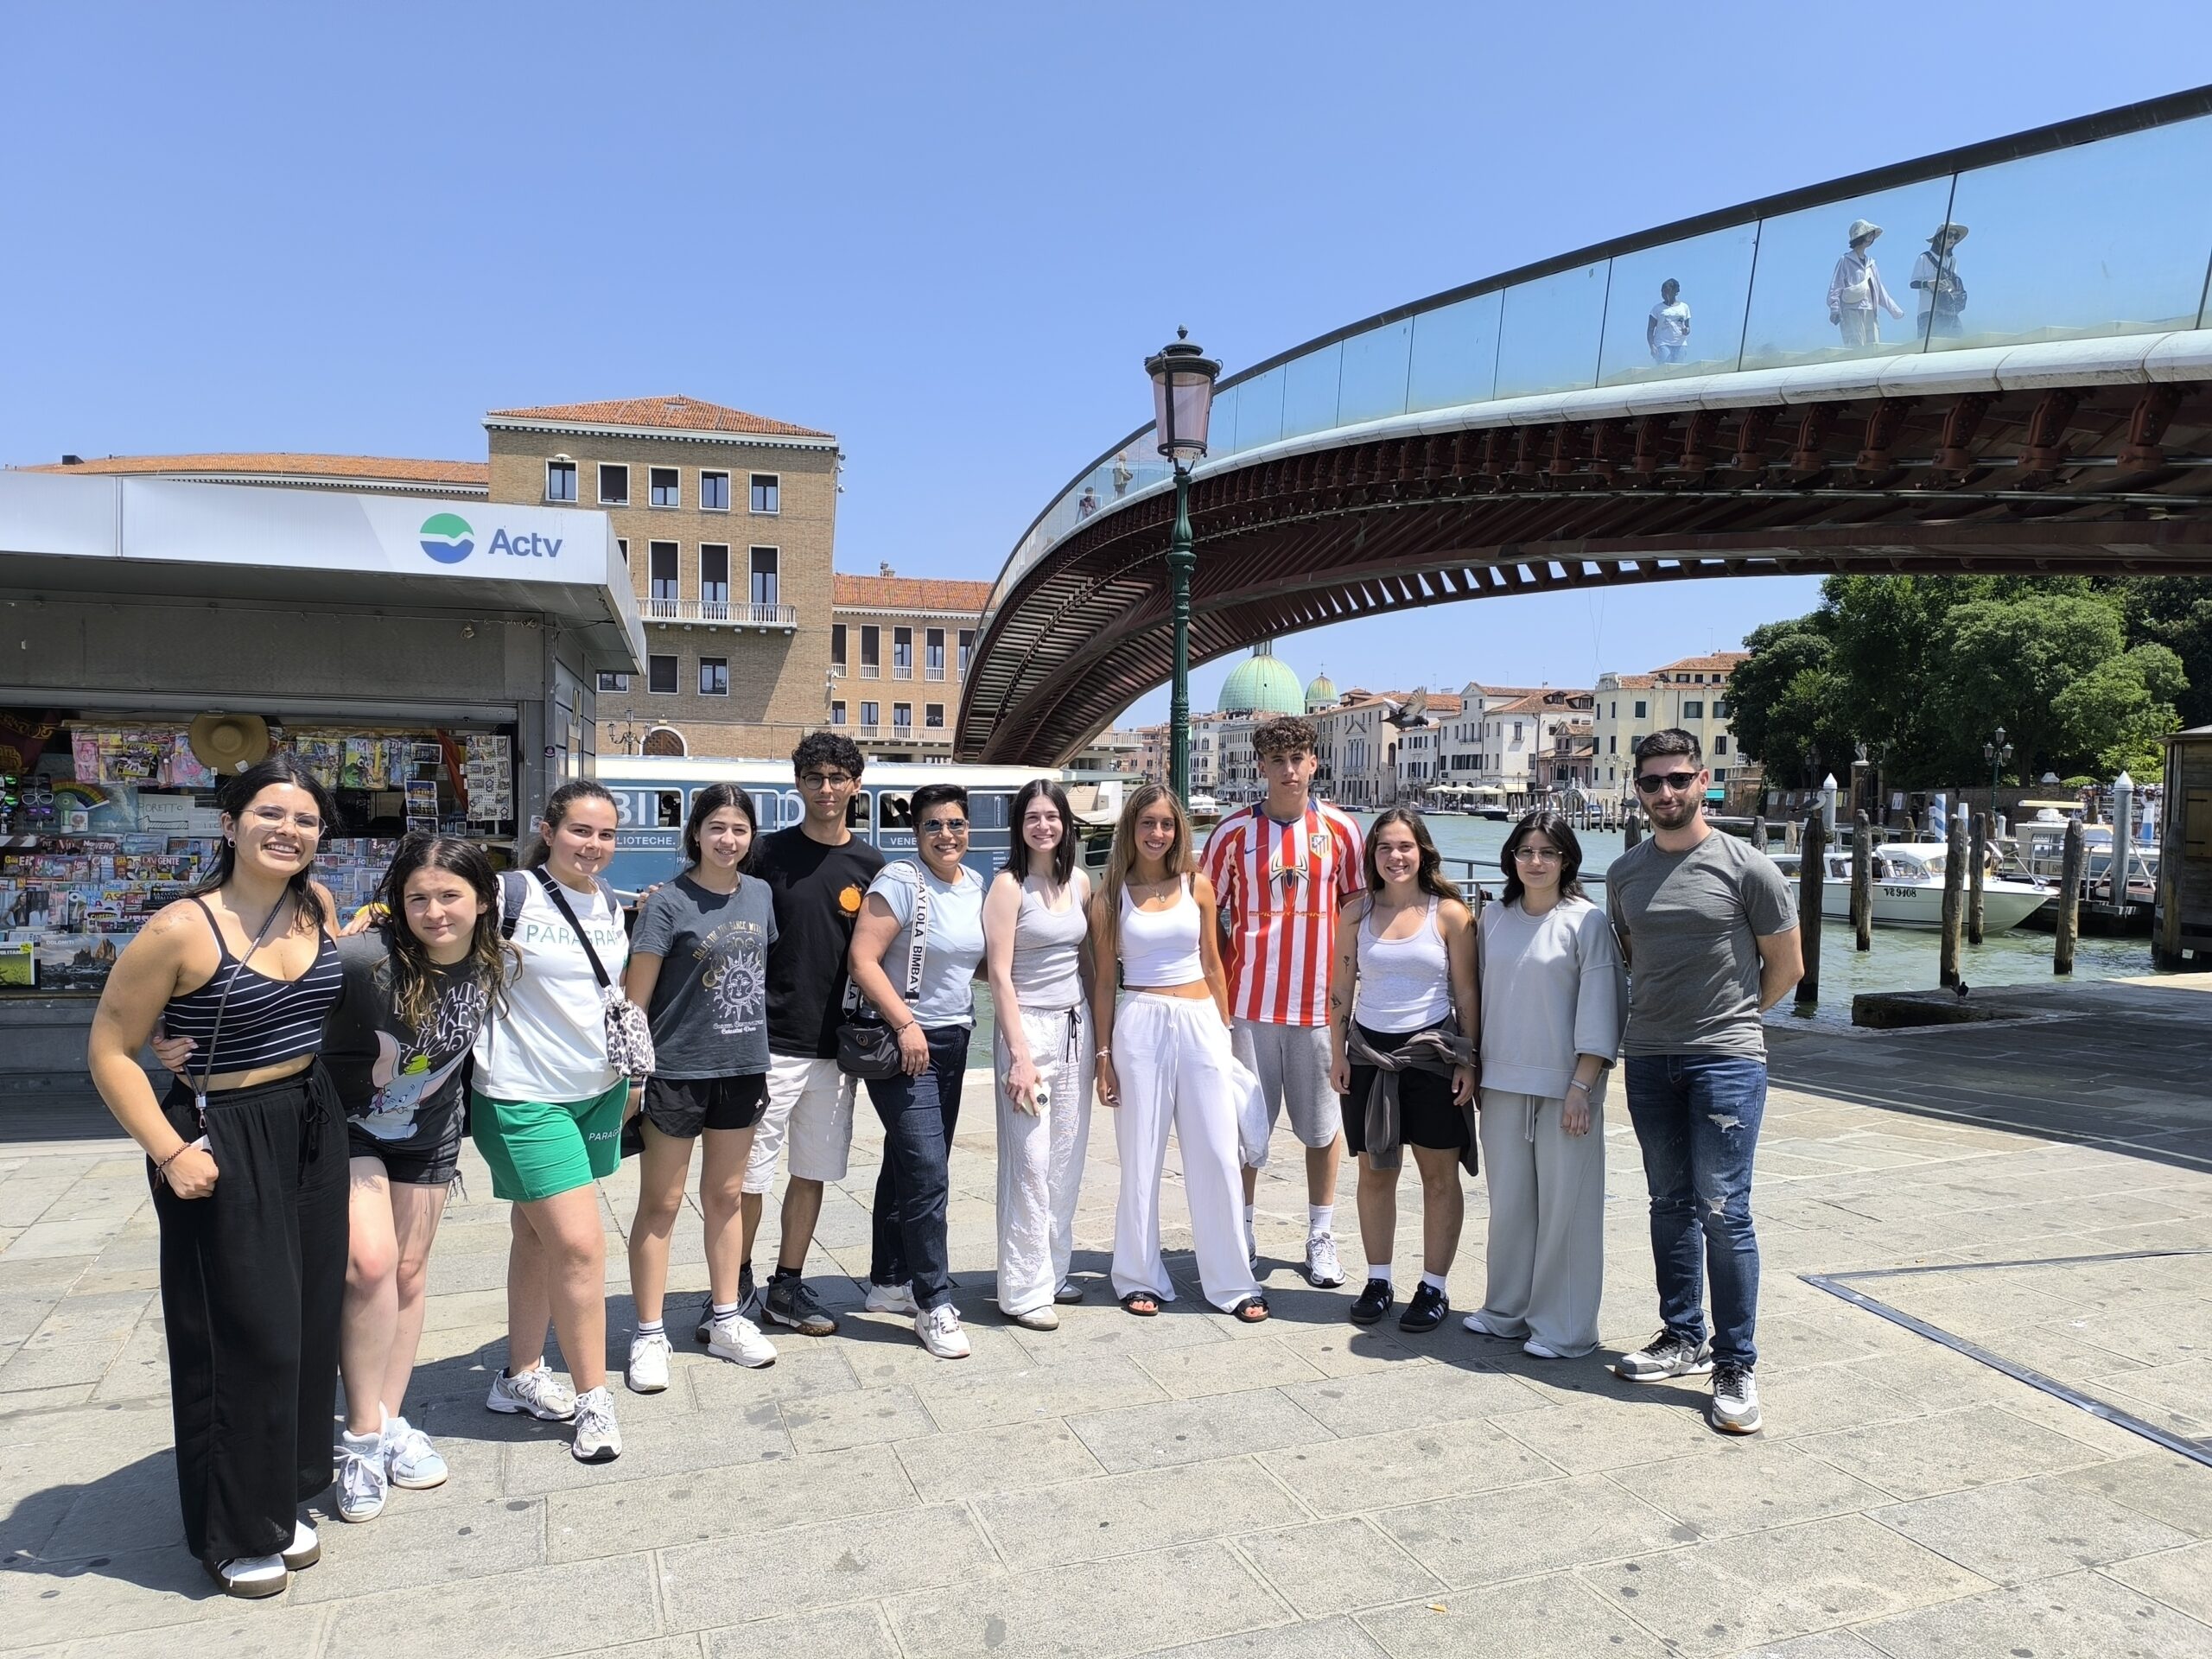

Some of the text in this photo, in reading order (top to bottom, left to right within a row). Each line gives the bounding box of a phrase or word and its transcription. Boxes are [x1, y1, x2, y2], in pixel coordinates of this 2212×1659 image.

[487, 528, 563, 558] Actv
[157, 856, 180, 866] GENTE
[914, 906, 926, 938] LOLA
[910, 945, 923, 984] BIMBA
